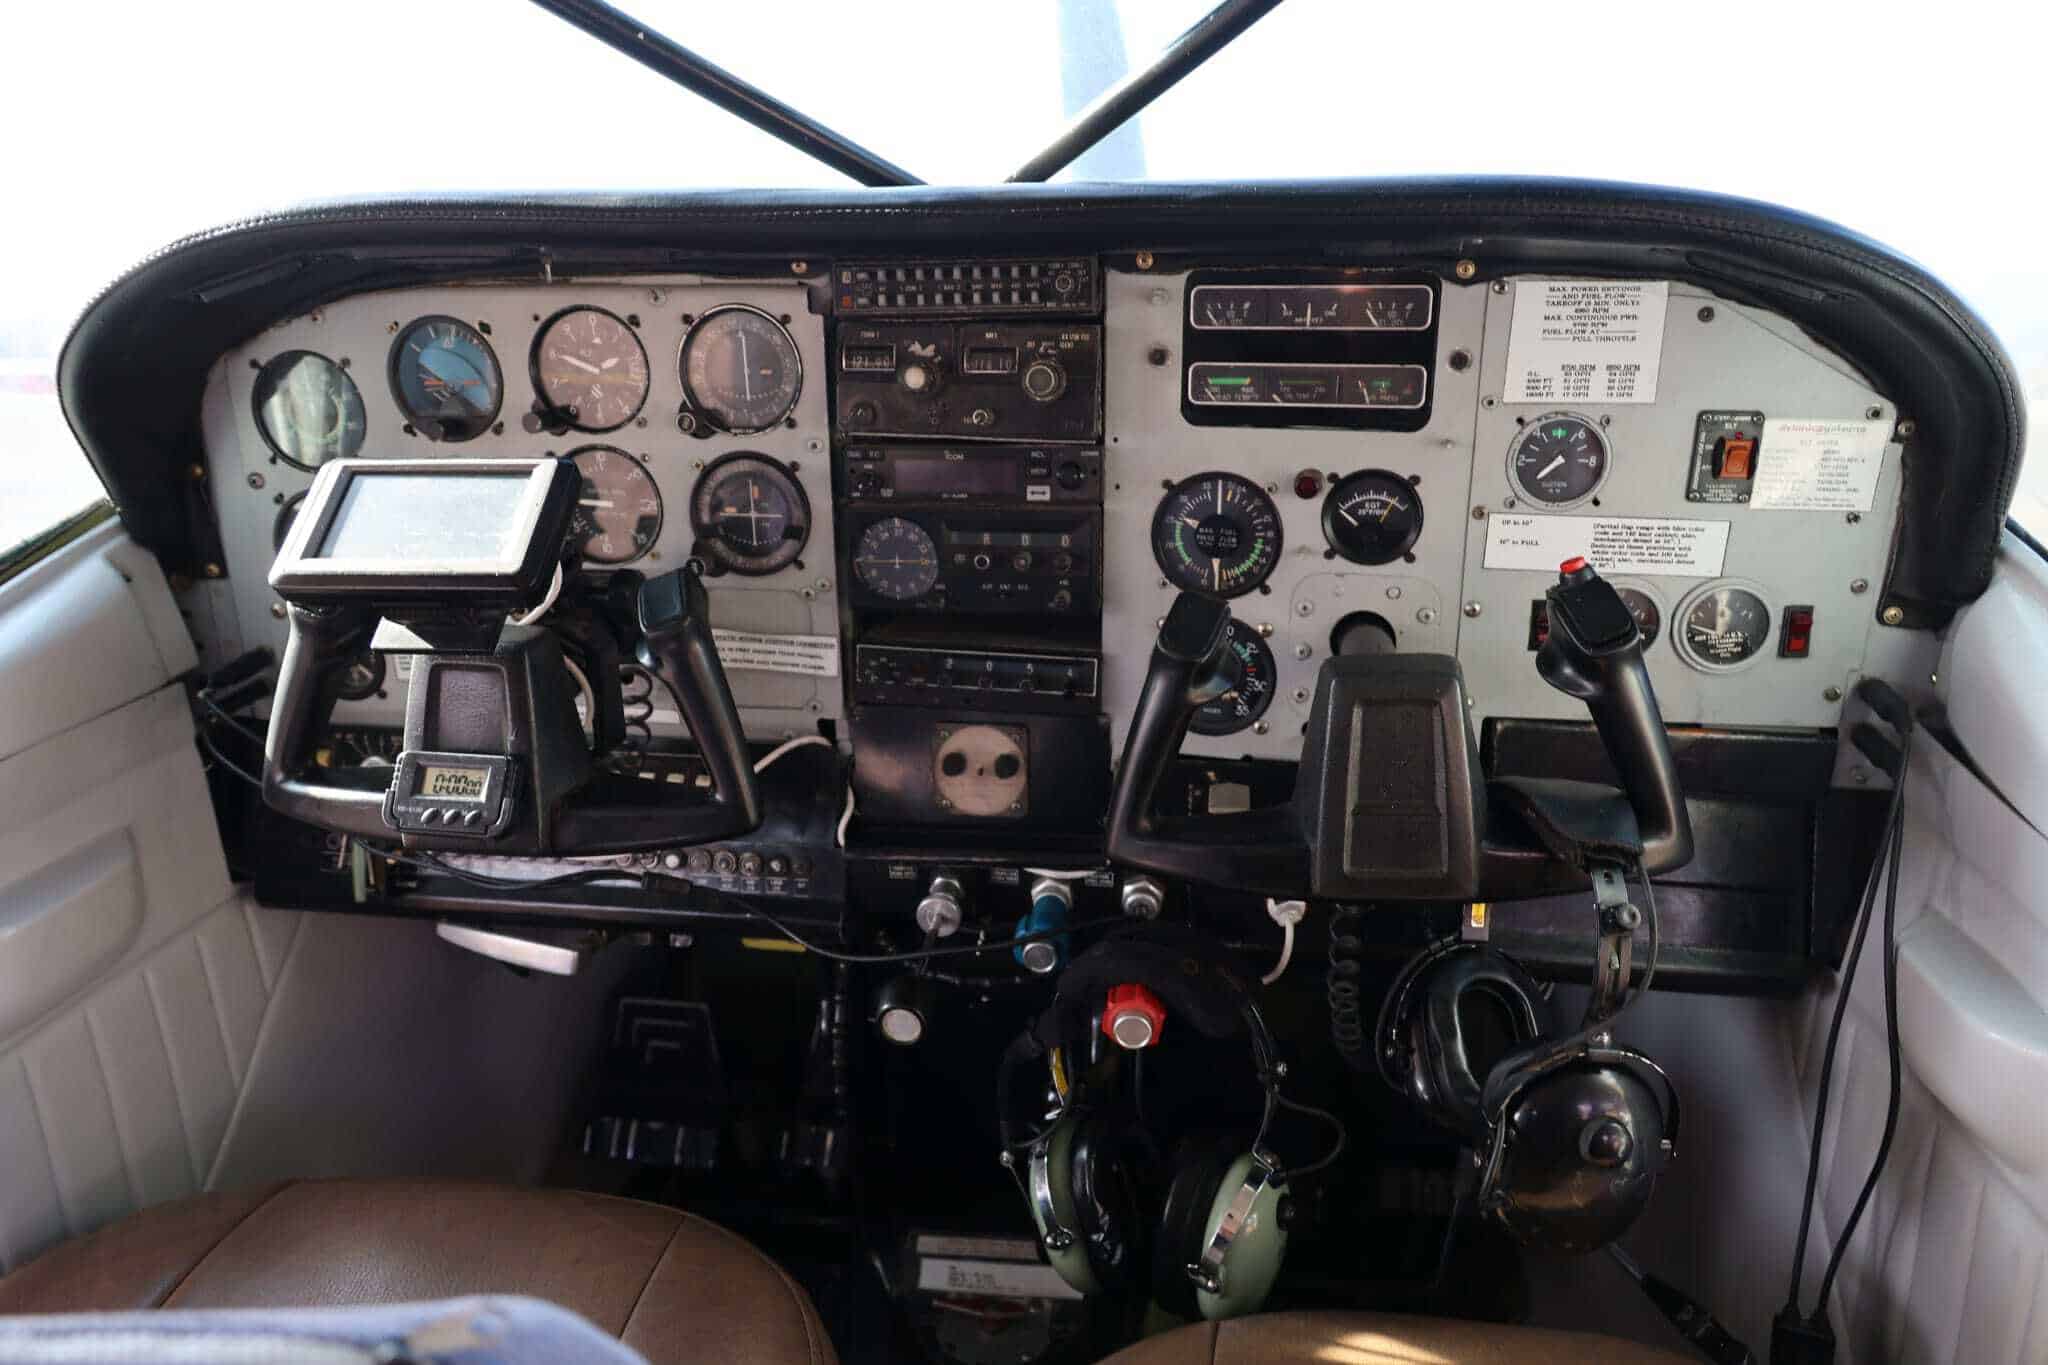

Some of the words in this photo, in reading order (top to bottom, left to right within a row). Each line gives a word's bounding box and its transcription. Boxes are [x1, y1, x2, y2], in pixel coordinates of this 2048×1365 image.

[1578, 427, 1586, 440] 6
[1518, 454, 1527, 466] 2
[1588, 455, 1597, 467] 8
[1364, 501, 1381, 510] EGT
